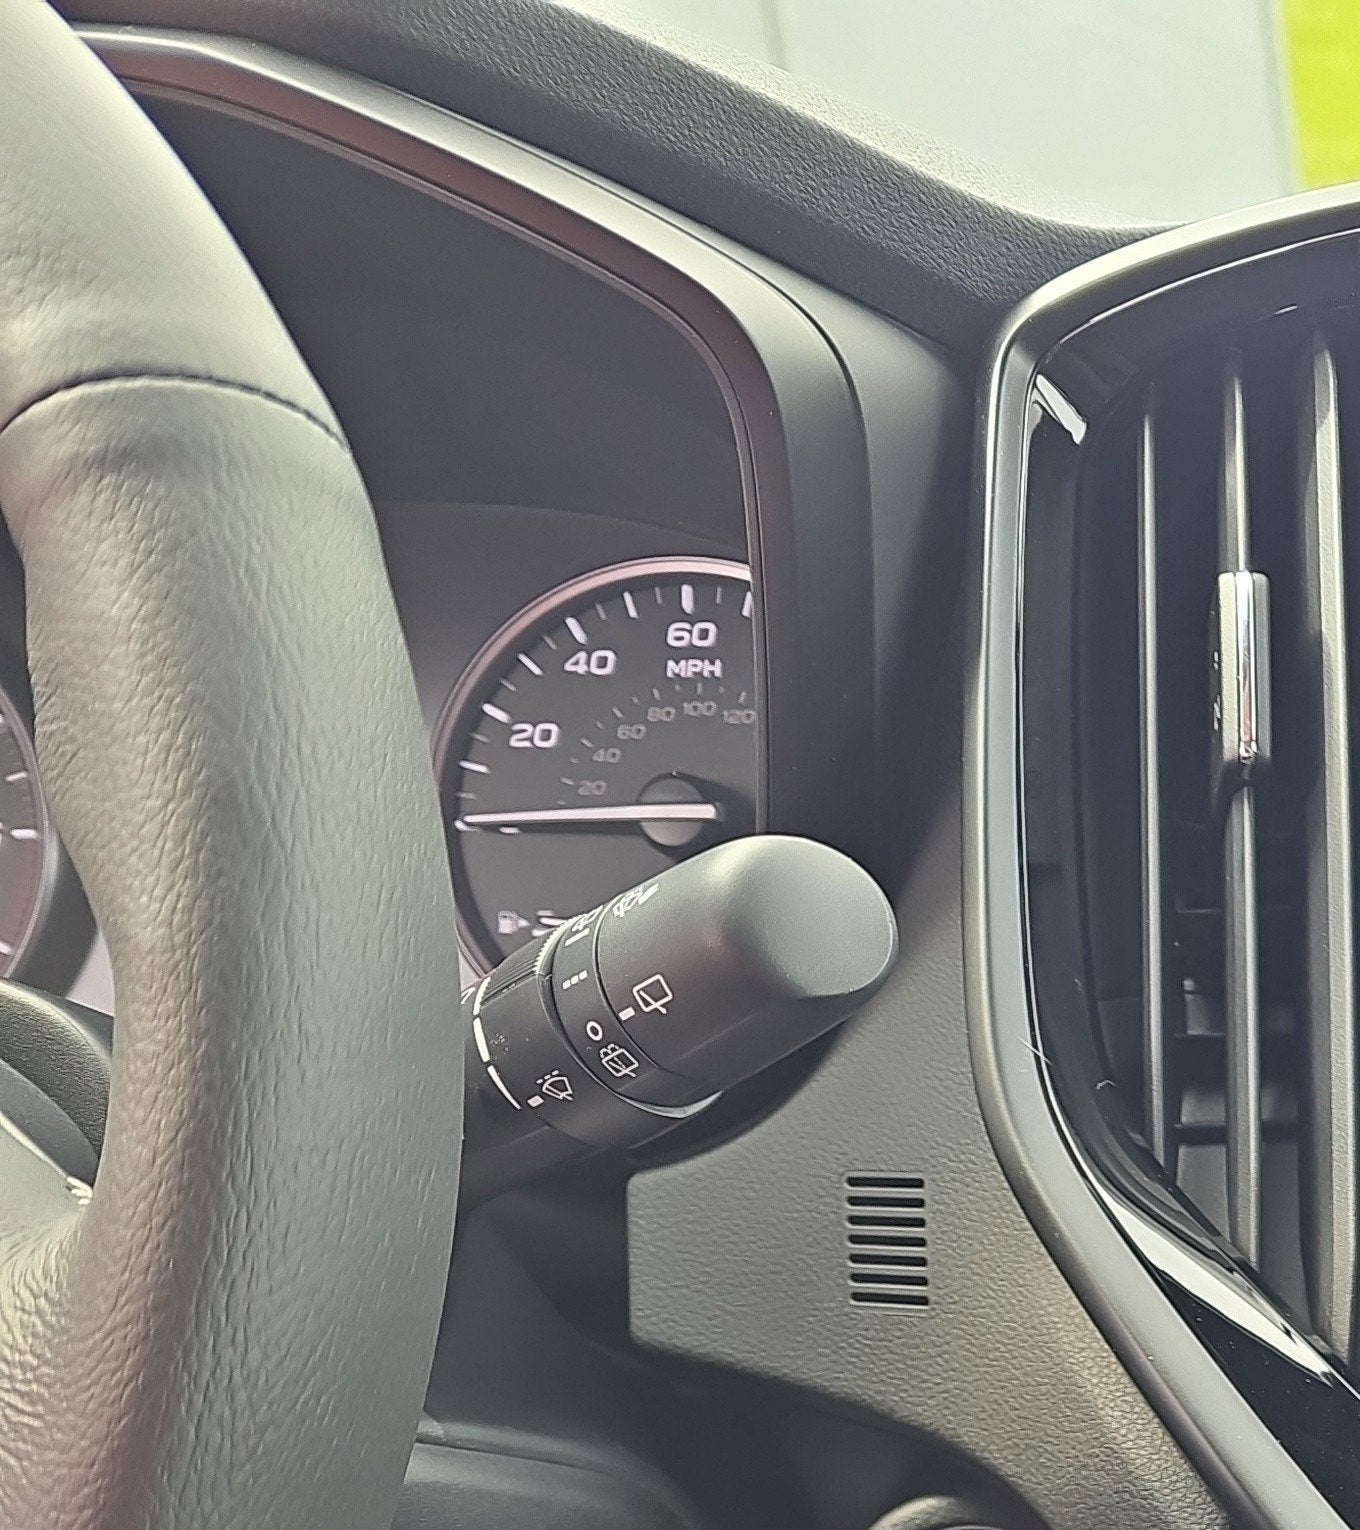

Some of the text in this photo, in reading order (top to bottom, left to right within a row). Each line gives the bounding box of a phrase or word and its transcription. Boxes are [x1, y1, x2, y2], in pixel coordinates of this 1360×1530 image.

[666, 621, 717, 647] 60
[564, 650, 617, 676] 40
[666, 658, 722, 678] MPH
[683, 701, 717, 716] 100
[509, 722, 559, 748] 20
[617, 724, 646, 739] 60
[593, 748, 621, 763] 40
[578, 780, 607, 795] 20
